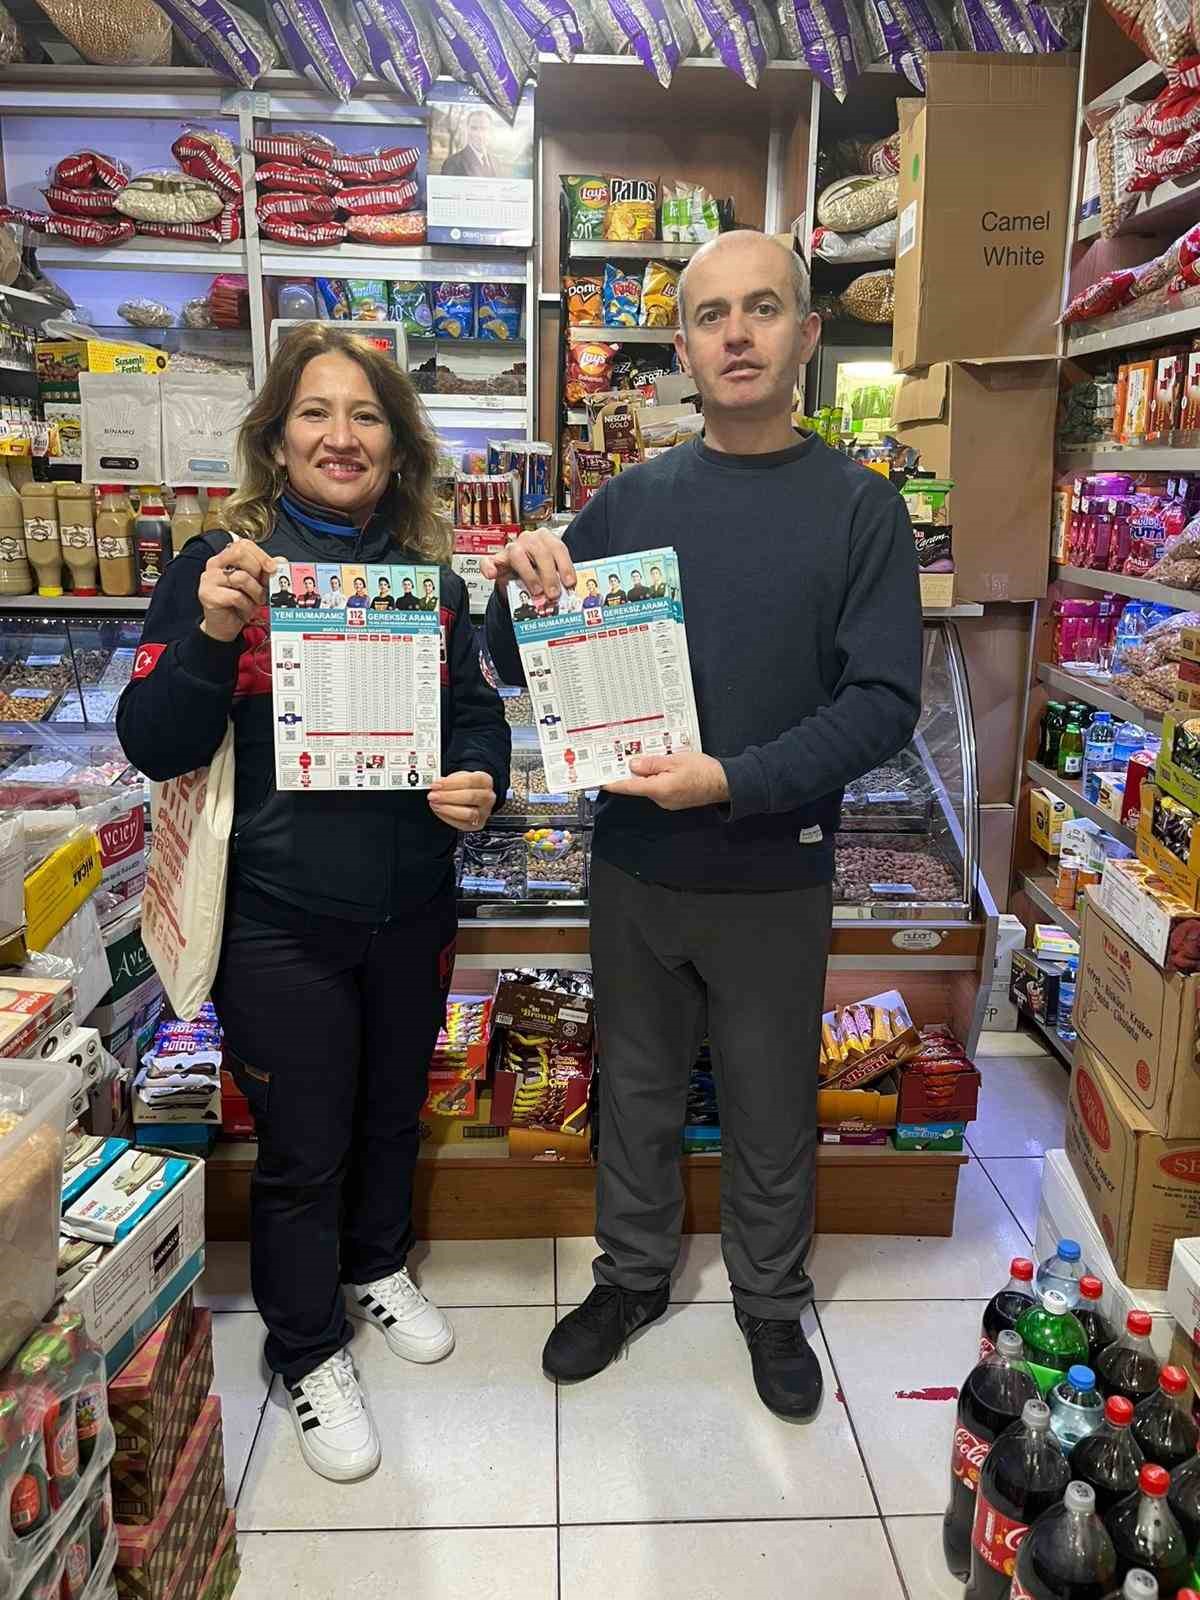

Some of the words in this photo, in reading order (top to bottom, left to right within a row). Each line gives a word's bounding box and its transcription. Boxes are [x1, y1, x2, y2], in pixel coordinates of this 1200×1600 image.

[982, 210, 1051, 232] Camel
[983, 246, 1045, 267] White
[274, 611, 294, 620] YENİ
[295, 612, 345, 621] NUMARAMIZ
[350, 609, 363, 619] 112
[409, 614, 438, 622] ARAMA
[587, 609, 599, 619] 112
